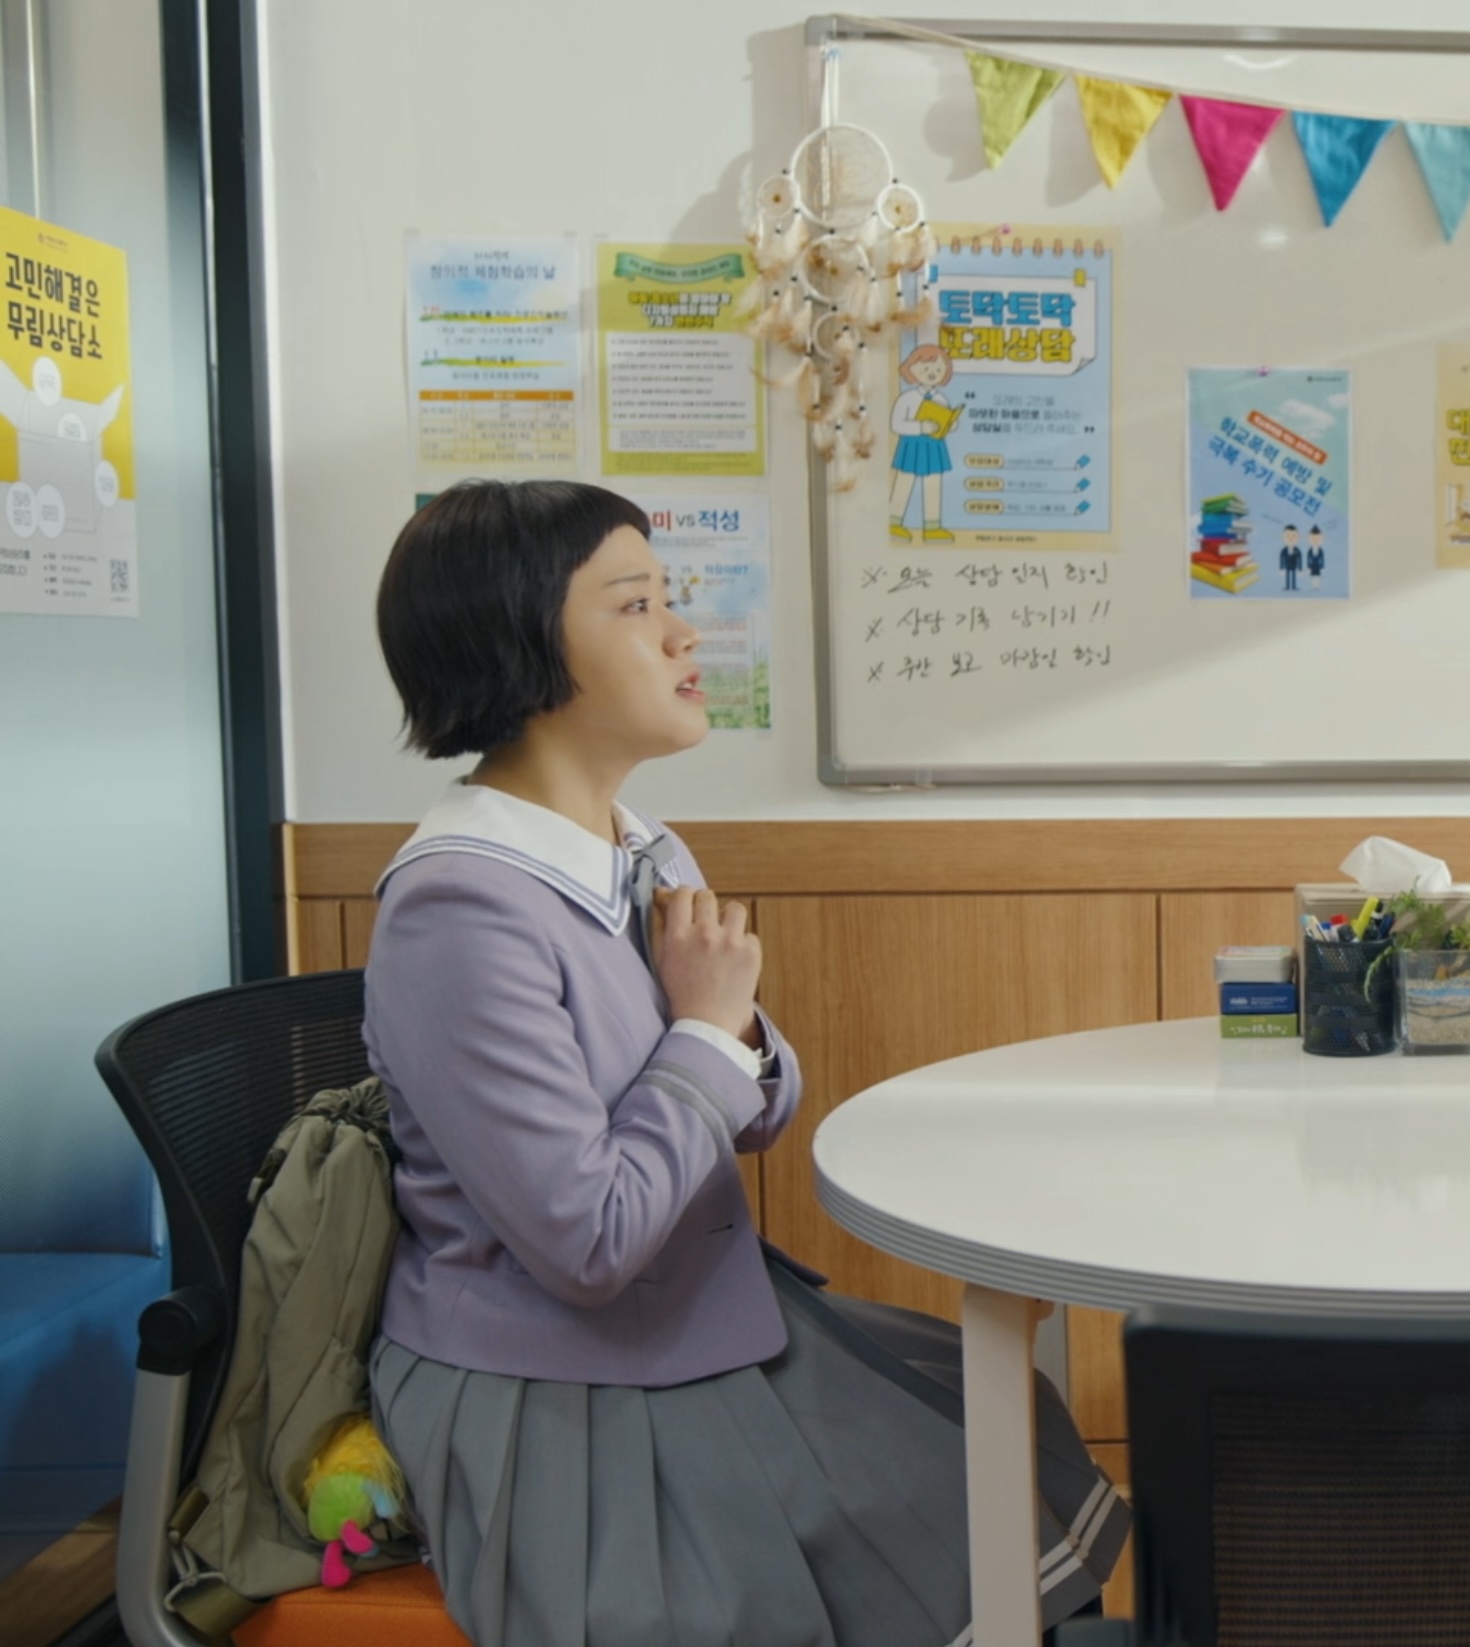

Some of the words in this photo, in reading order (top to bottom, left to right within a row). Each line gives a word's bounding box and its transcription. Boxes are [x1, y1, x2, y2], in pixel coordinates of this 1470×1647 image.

[6, 252, 100, 317] 고민해결은
[939, 290, 1076, 327] 토닥토닥
[7, 301, 102, 359] 무림상담소
[939, 326, 1076, 363] 또래상담
[1209, 435, 1240, 466] 극복
[1241, 459, 1274, 488] 수기
[1274, 477, 1322, 516] 공모전
[1220, 416, 1280, 464] 학교폭력
[1281, 456, 1313, 485] 예방
[1313, 476, 1333, 498] 및
[652, 509, 672, 531] 미
[698, 509, 740, 531] 적성
[955, 563, 1002, 588] 상담
[897, 607, 944, 637] 상담
[956, 605, 990, 632] 기록
[1011, 605, 1076, 629] 남기기
